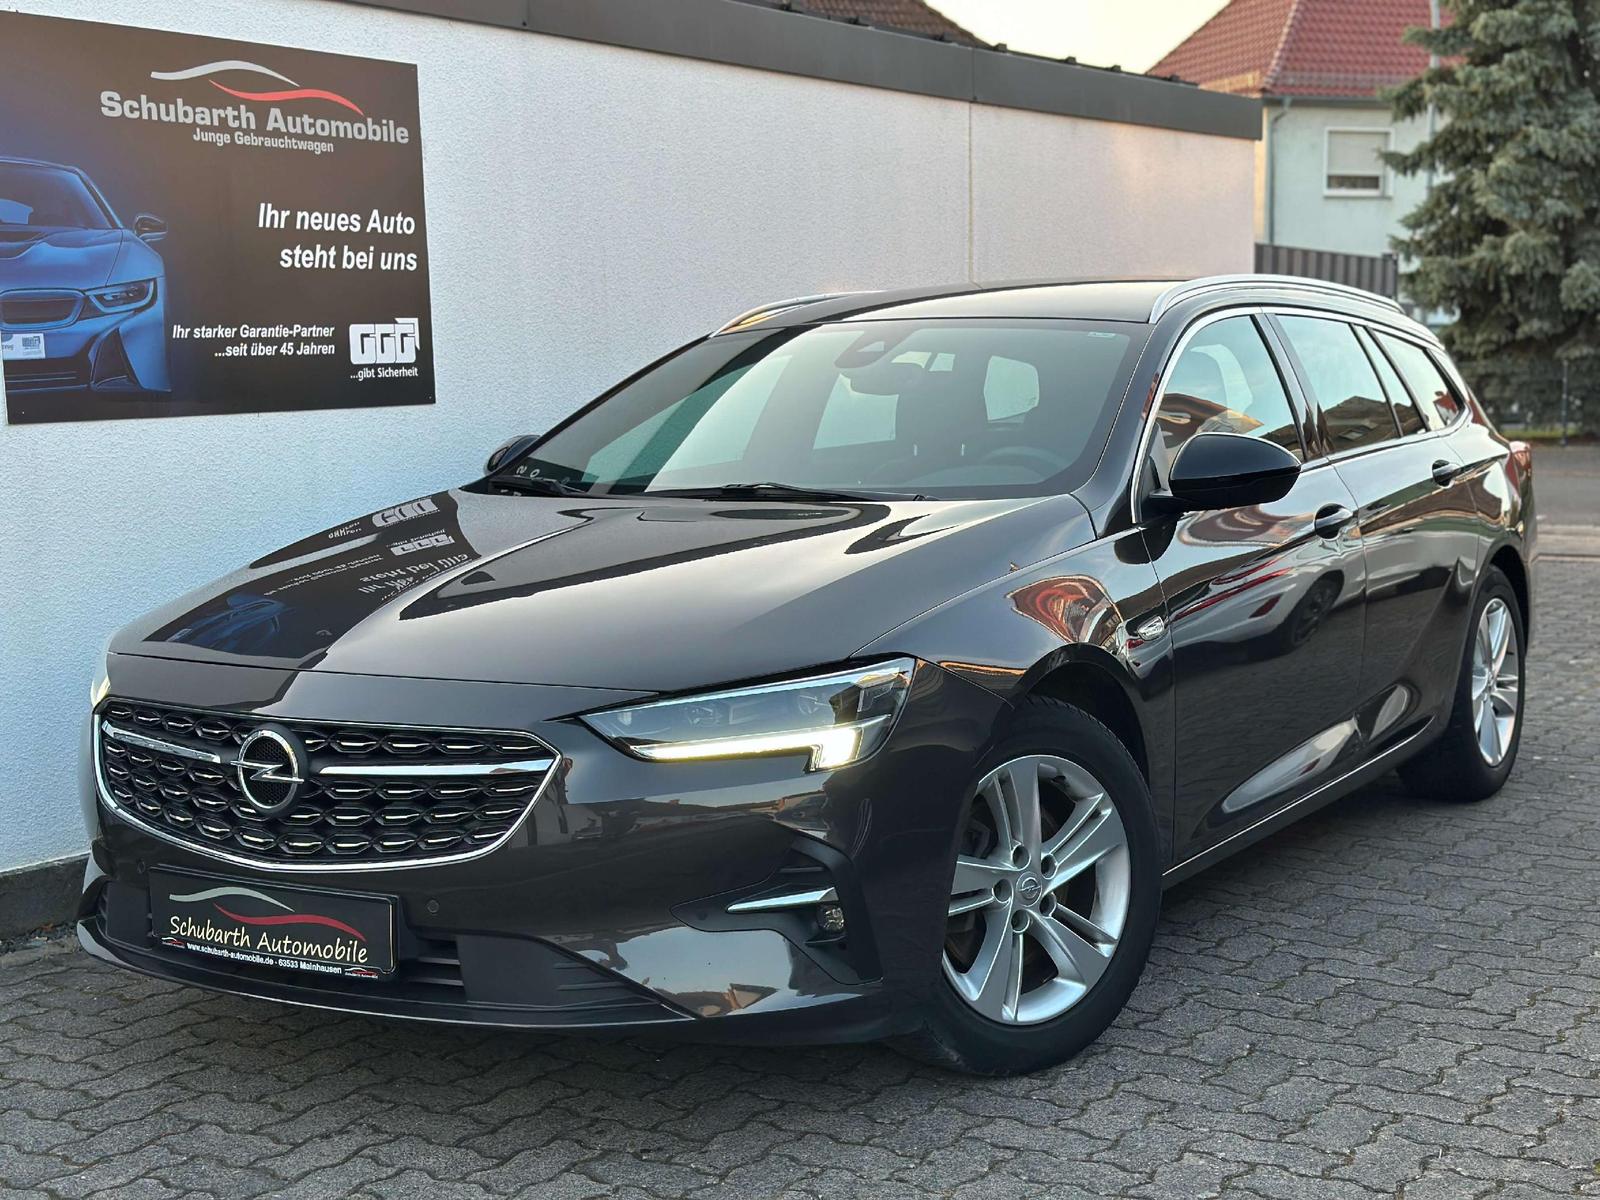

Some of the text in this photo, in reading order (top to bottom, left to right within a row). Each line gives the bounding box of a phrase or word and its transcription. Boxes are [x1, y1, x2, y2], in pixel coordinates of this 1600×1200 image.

[100, 91, 409, 144] Schubarth Automobile
[193, 127, 334, 155] Junge Gebrauchtwagen
[258, 203, 415, 235] Ihr neues Auto
[280, 244, 417, 271] steht bei uns
[172, 324, 335, 338] Ihr starker Garantie-Partner
[214, 342, 335, 357] ...seit über 45 Jahren
[350, 367, 419, 382] ...gibt Sicherheit
[170, 916, 368, 963] Schubarth Automobile
[187, 942, 274, 966] www.schubarth-automobile.de
[278, 959, 299, 969] 63533
[300, 961, 342, 974] Mainhausen
